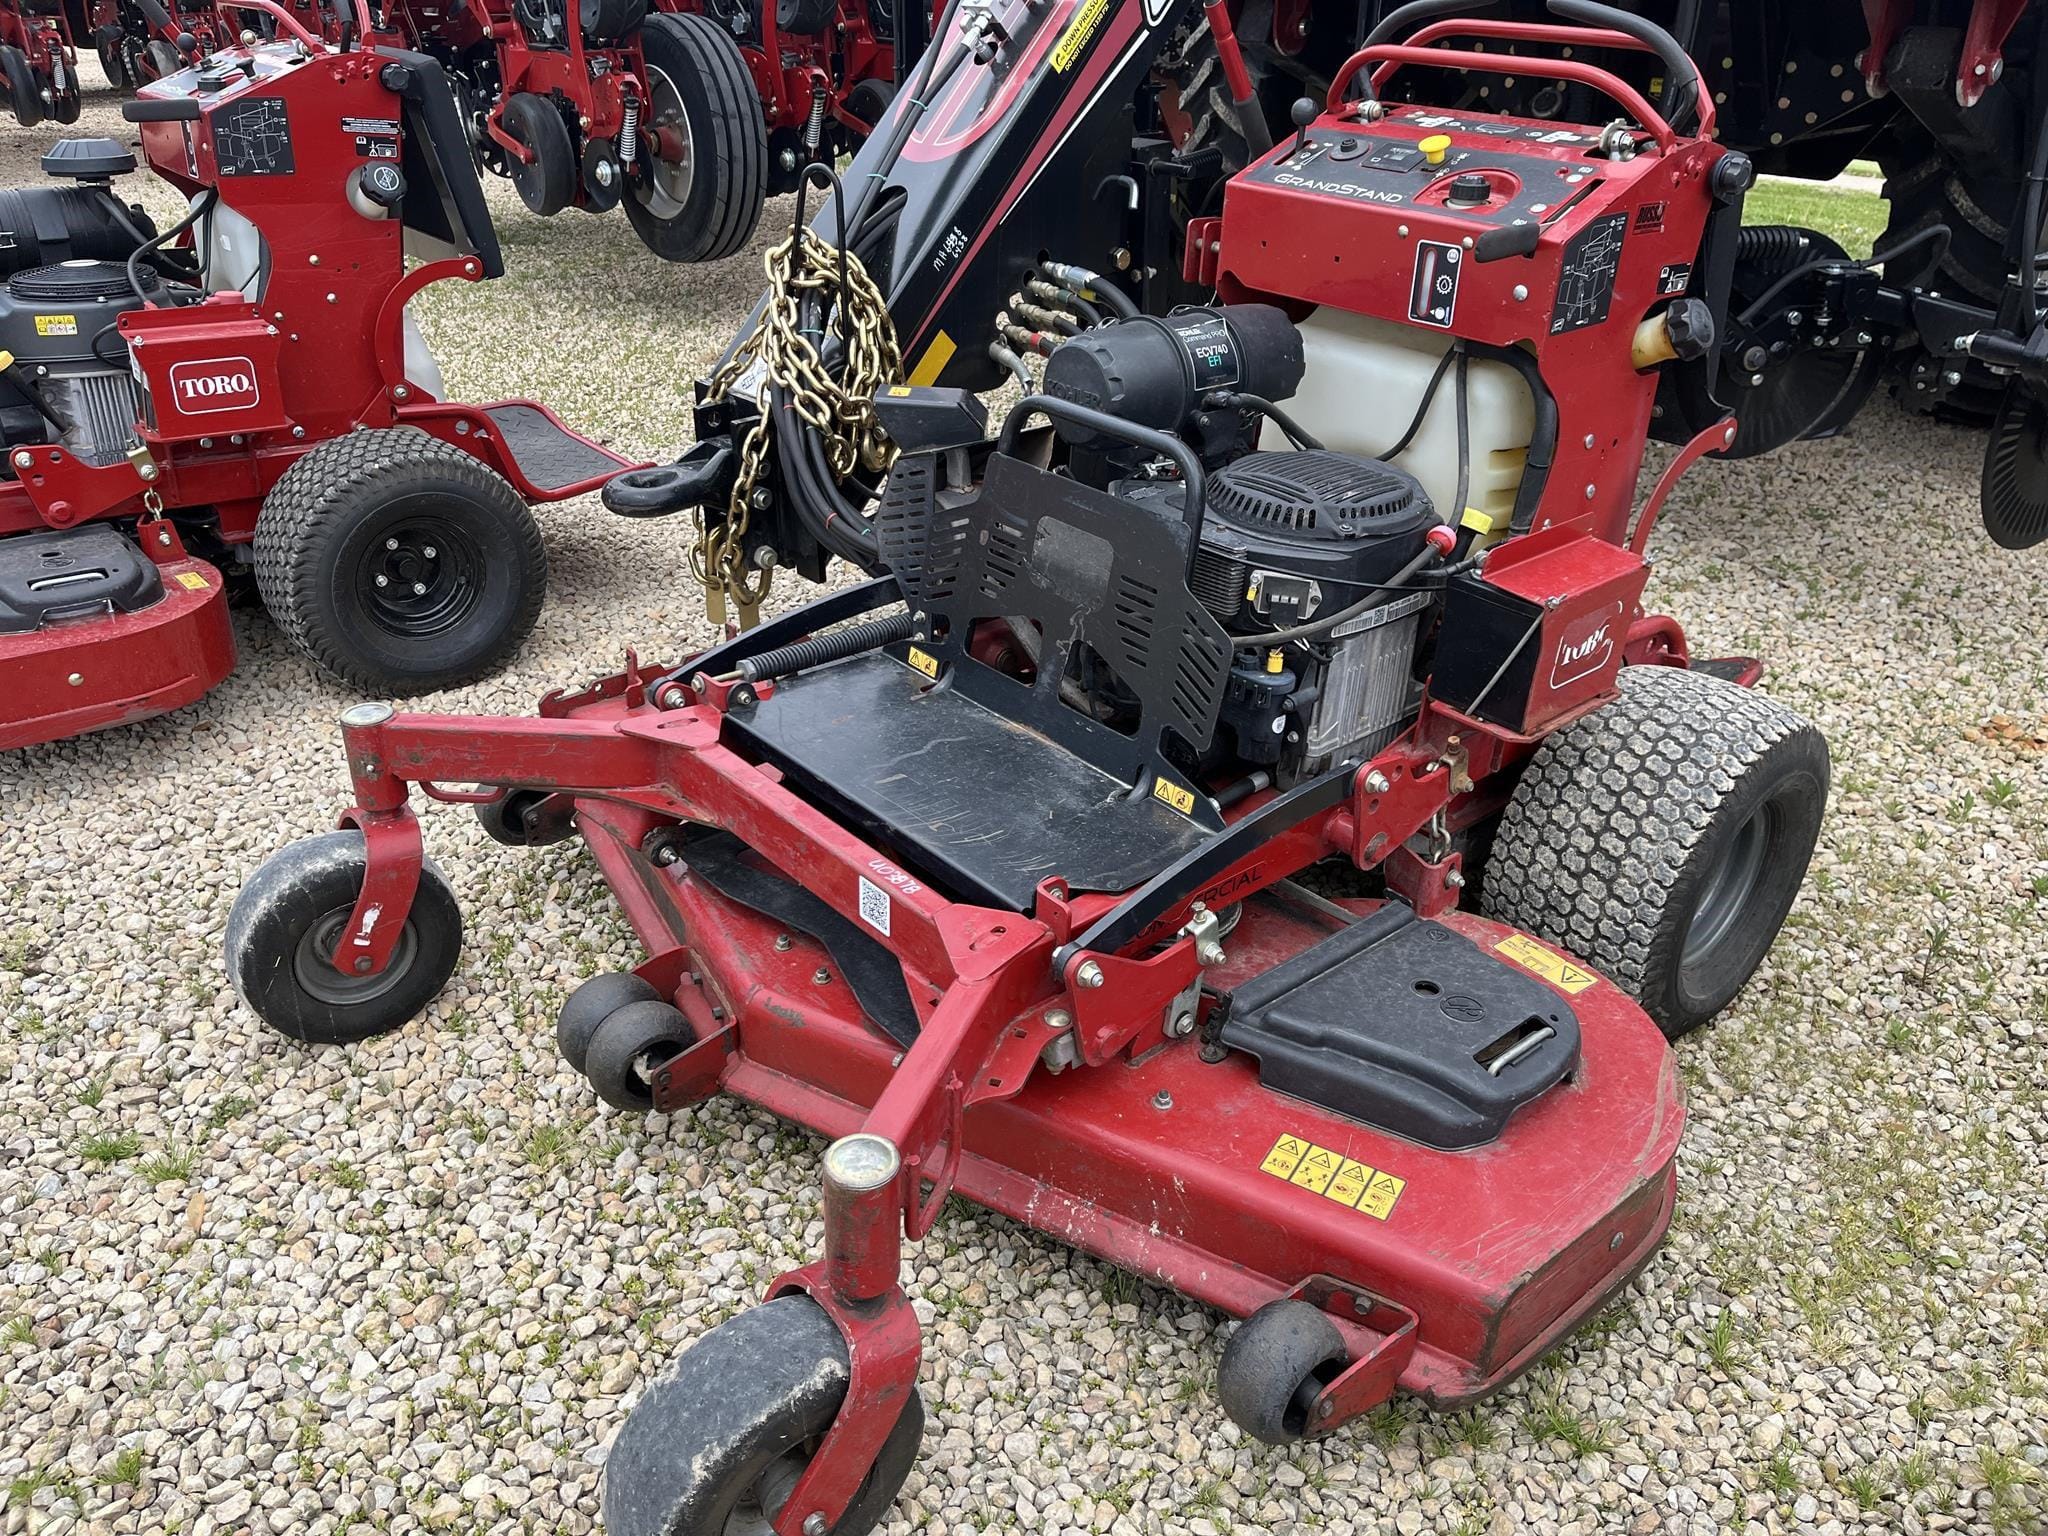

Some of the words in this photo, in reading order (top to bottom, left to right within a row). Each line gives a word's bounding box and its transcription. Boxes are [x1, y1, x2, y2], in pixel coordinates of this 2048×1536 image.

[1061, 26, 1080, 53] DOWN
[1064, 61, 1073, 71] DO
[1071, 48, 1081, 64] NOT
[1183, 332, 1212, 343] Command
[1211, 329, 1226, 339] PRO
[1196, 344, 1229, 358] ECV740
[1208, 355, 1223, 367] EFI
[179, 373, 250, 398] TORO
